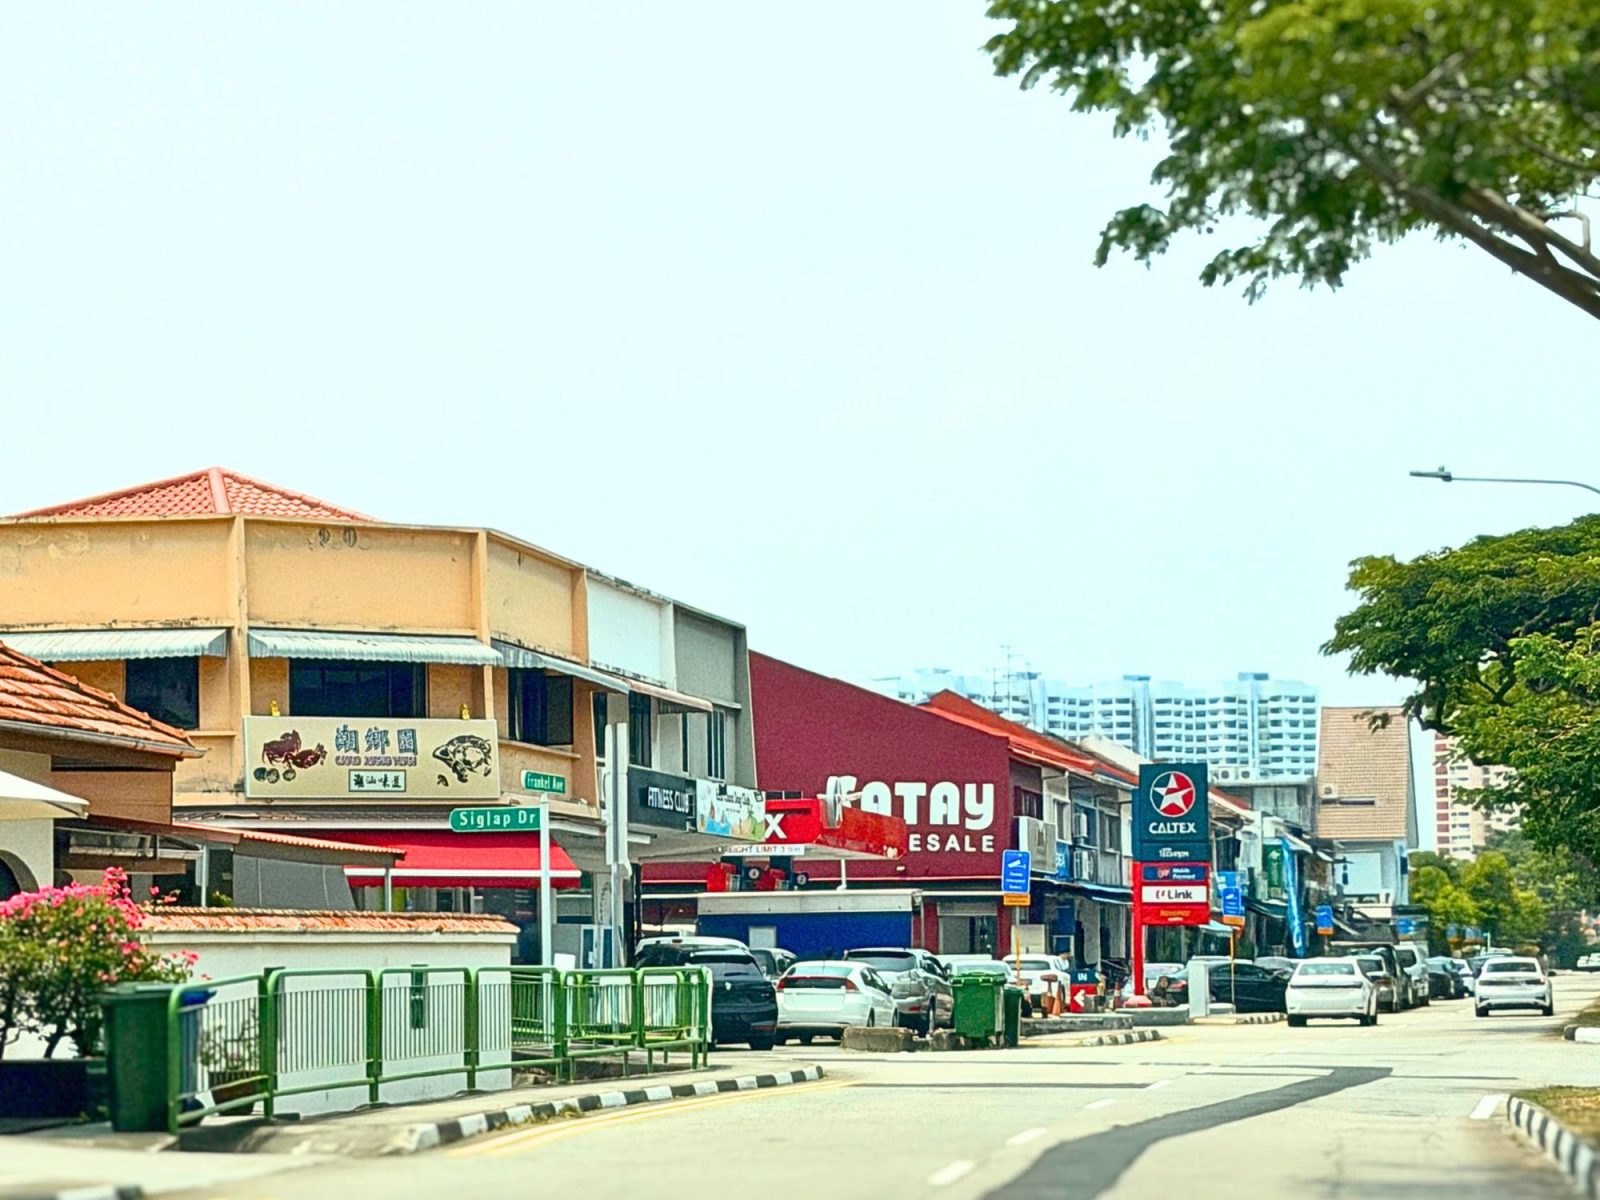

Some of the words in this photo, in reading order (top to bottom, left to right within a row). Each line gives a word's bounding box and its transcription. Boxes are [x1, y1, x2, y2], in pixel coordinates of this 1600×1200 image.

[527, 773, 551, 790] Frankel
[552, 776, 563, 792] Ave
[459, 812, 511, 829] Siglap
[518, 811, 536, 824] Dr
[1148, 822, 1197, 834] CALTEX
[908, 833, 995, 853] ESALE
[1167, 889, 1193, 900] Link
[1077, 972, 1088, 982] IN
